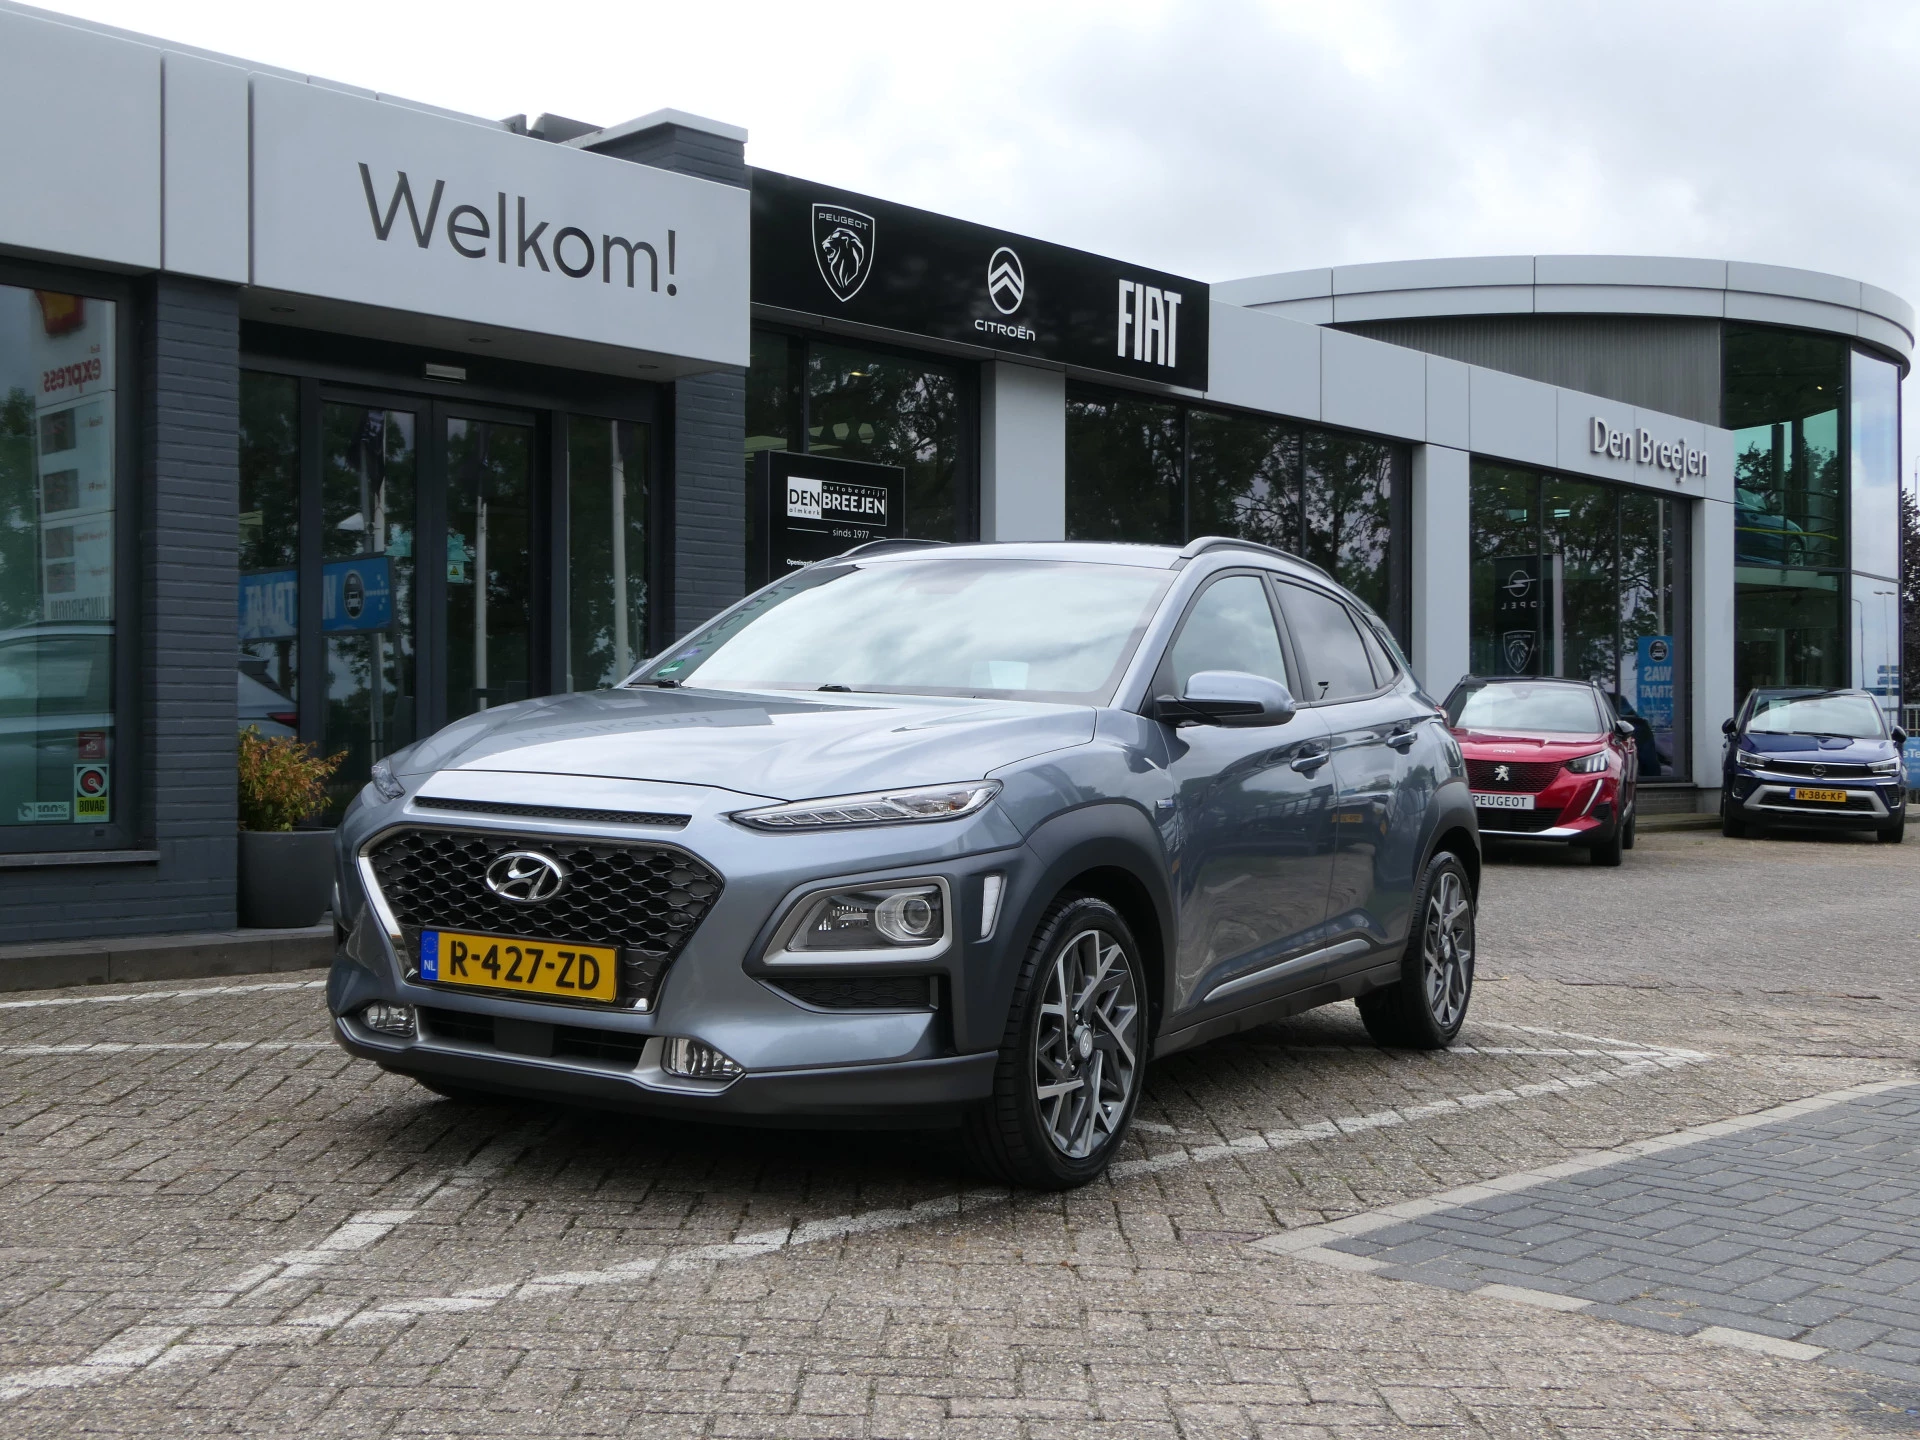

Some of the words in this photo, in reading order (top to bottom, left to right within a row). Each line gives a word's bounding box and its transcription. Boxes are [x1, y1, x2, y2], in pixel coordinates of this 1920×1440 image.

[818, 212, 869, 230] PEUGEOT
[358, 162, 677, 296] Welkom!
[1117, 278, 1182, 368] FIAT
[1590, 416, 1633, 460] Den
[1636, 427, 1709, 483] Breejen
[822, 484, 886, 497] autobedrijf
[789, 488, 821, 508] DEN
[822, 492, 886, 515] BREEJEN
[832, 528, 852, 538] sinds
[853, 529, 870, 539] 1977
[1472, 795, 1527, 807] PEUGEOT
[1798, 790, 1844, 800] N-386-KF
[79, 800, 105, 813] BOVAG
[423, 959, 436, 972] NL
[450, 940, 600, 991] R-427-ZD
